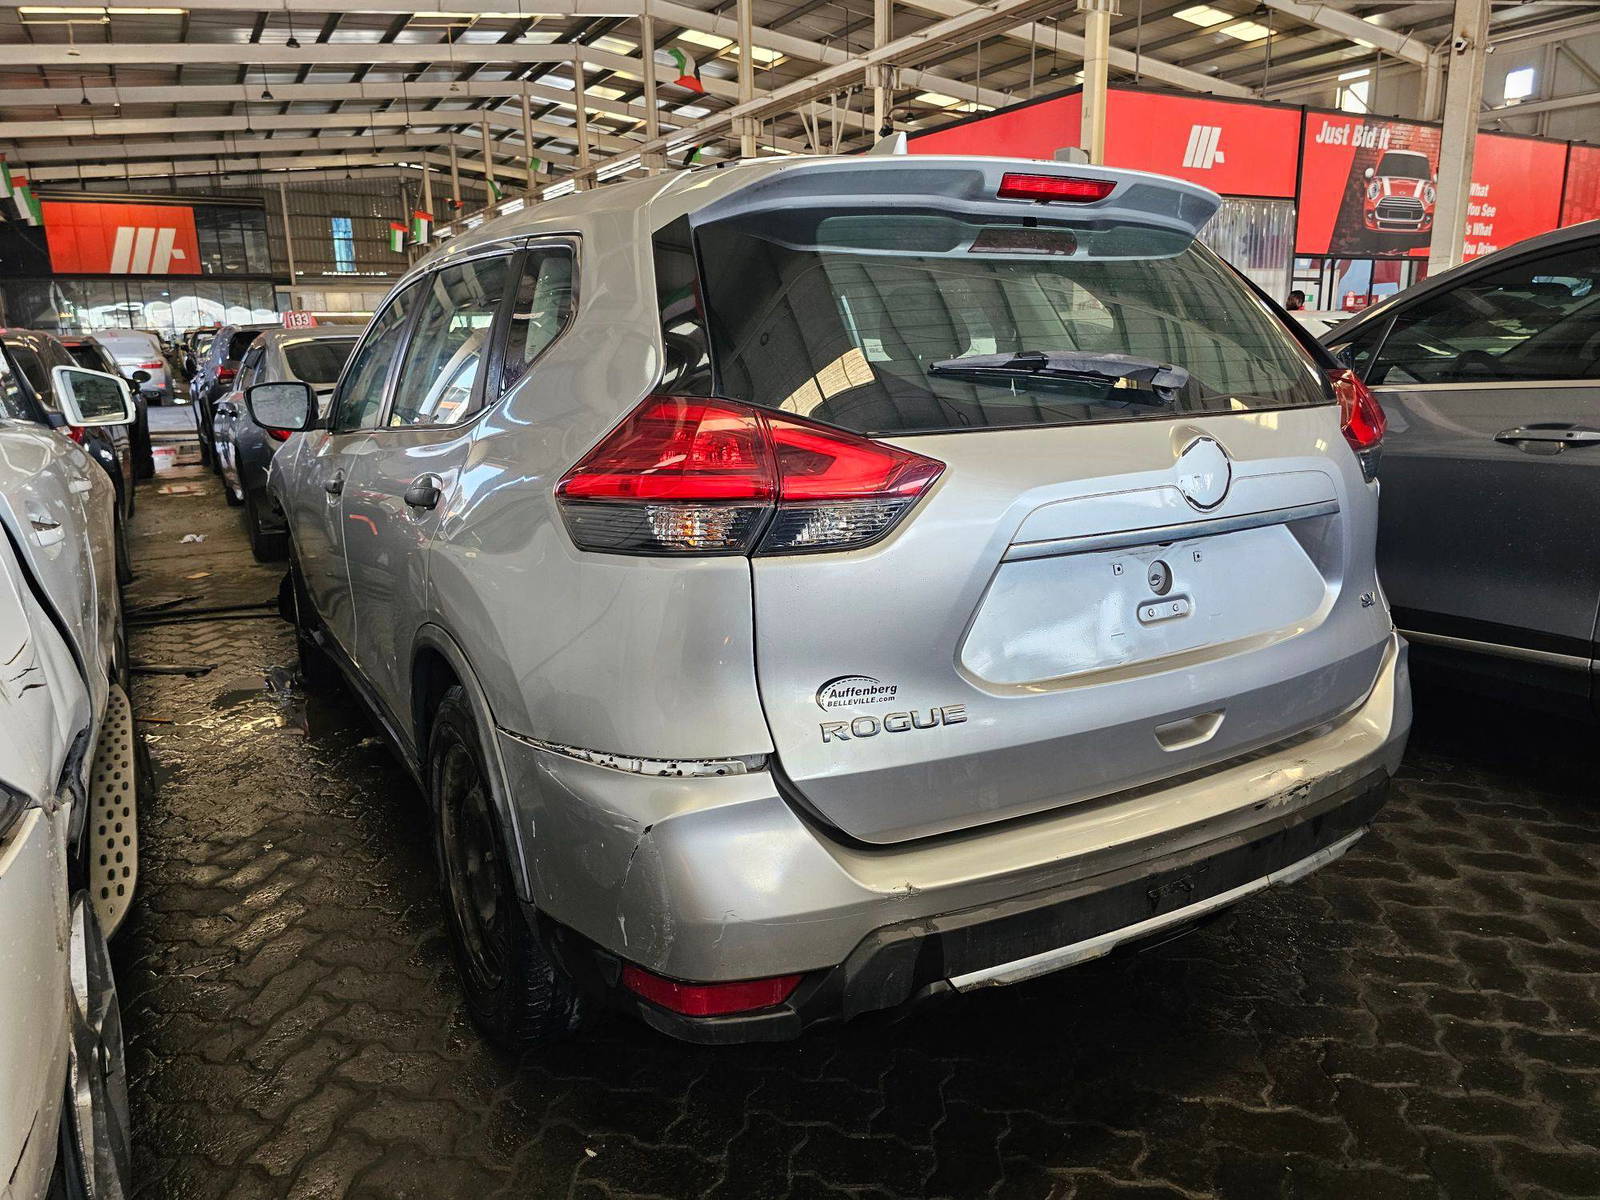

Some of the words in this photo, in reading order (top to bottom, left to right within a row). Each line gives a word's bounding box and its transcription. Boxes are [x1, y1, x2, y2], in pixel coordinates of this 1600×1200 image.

[1315, 120, 1350, 146] Just
[1351, 124, 1378, 149] Bid
[1378, 127, 1391, 151] It
[1481, 203, 1497, 217] See
[1472, 222, 1494, 237] What
[290, 313, 309, 326] 133
[828, 684, 898, 699] Auffenberg
[827, 695, 896, 708] BELLEVILLE.com
[819, 703, 968, 743] ROGUE
